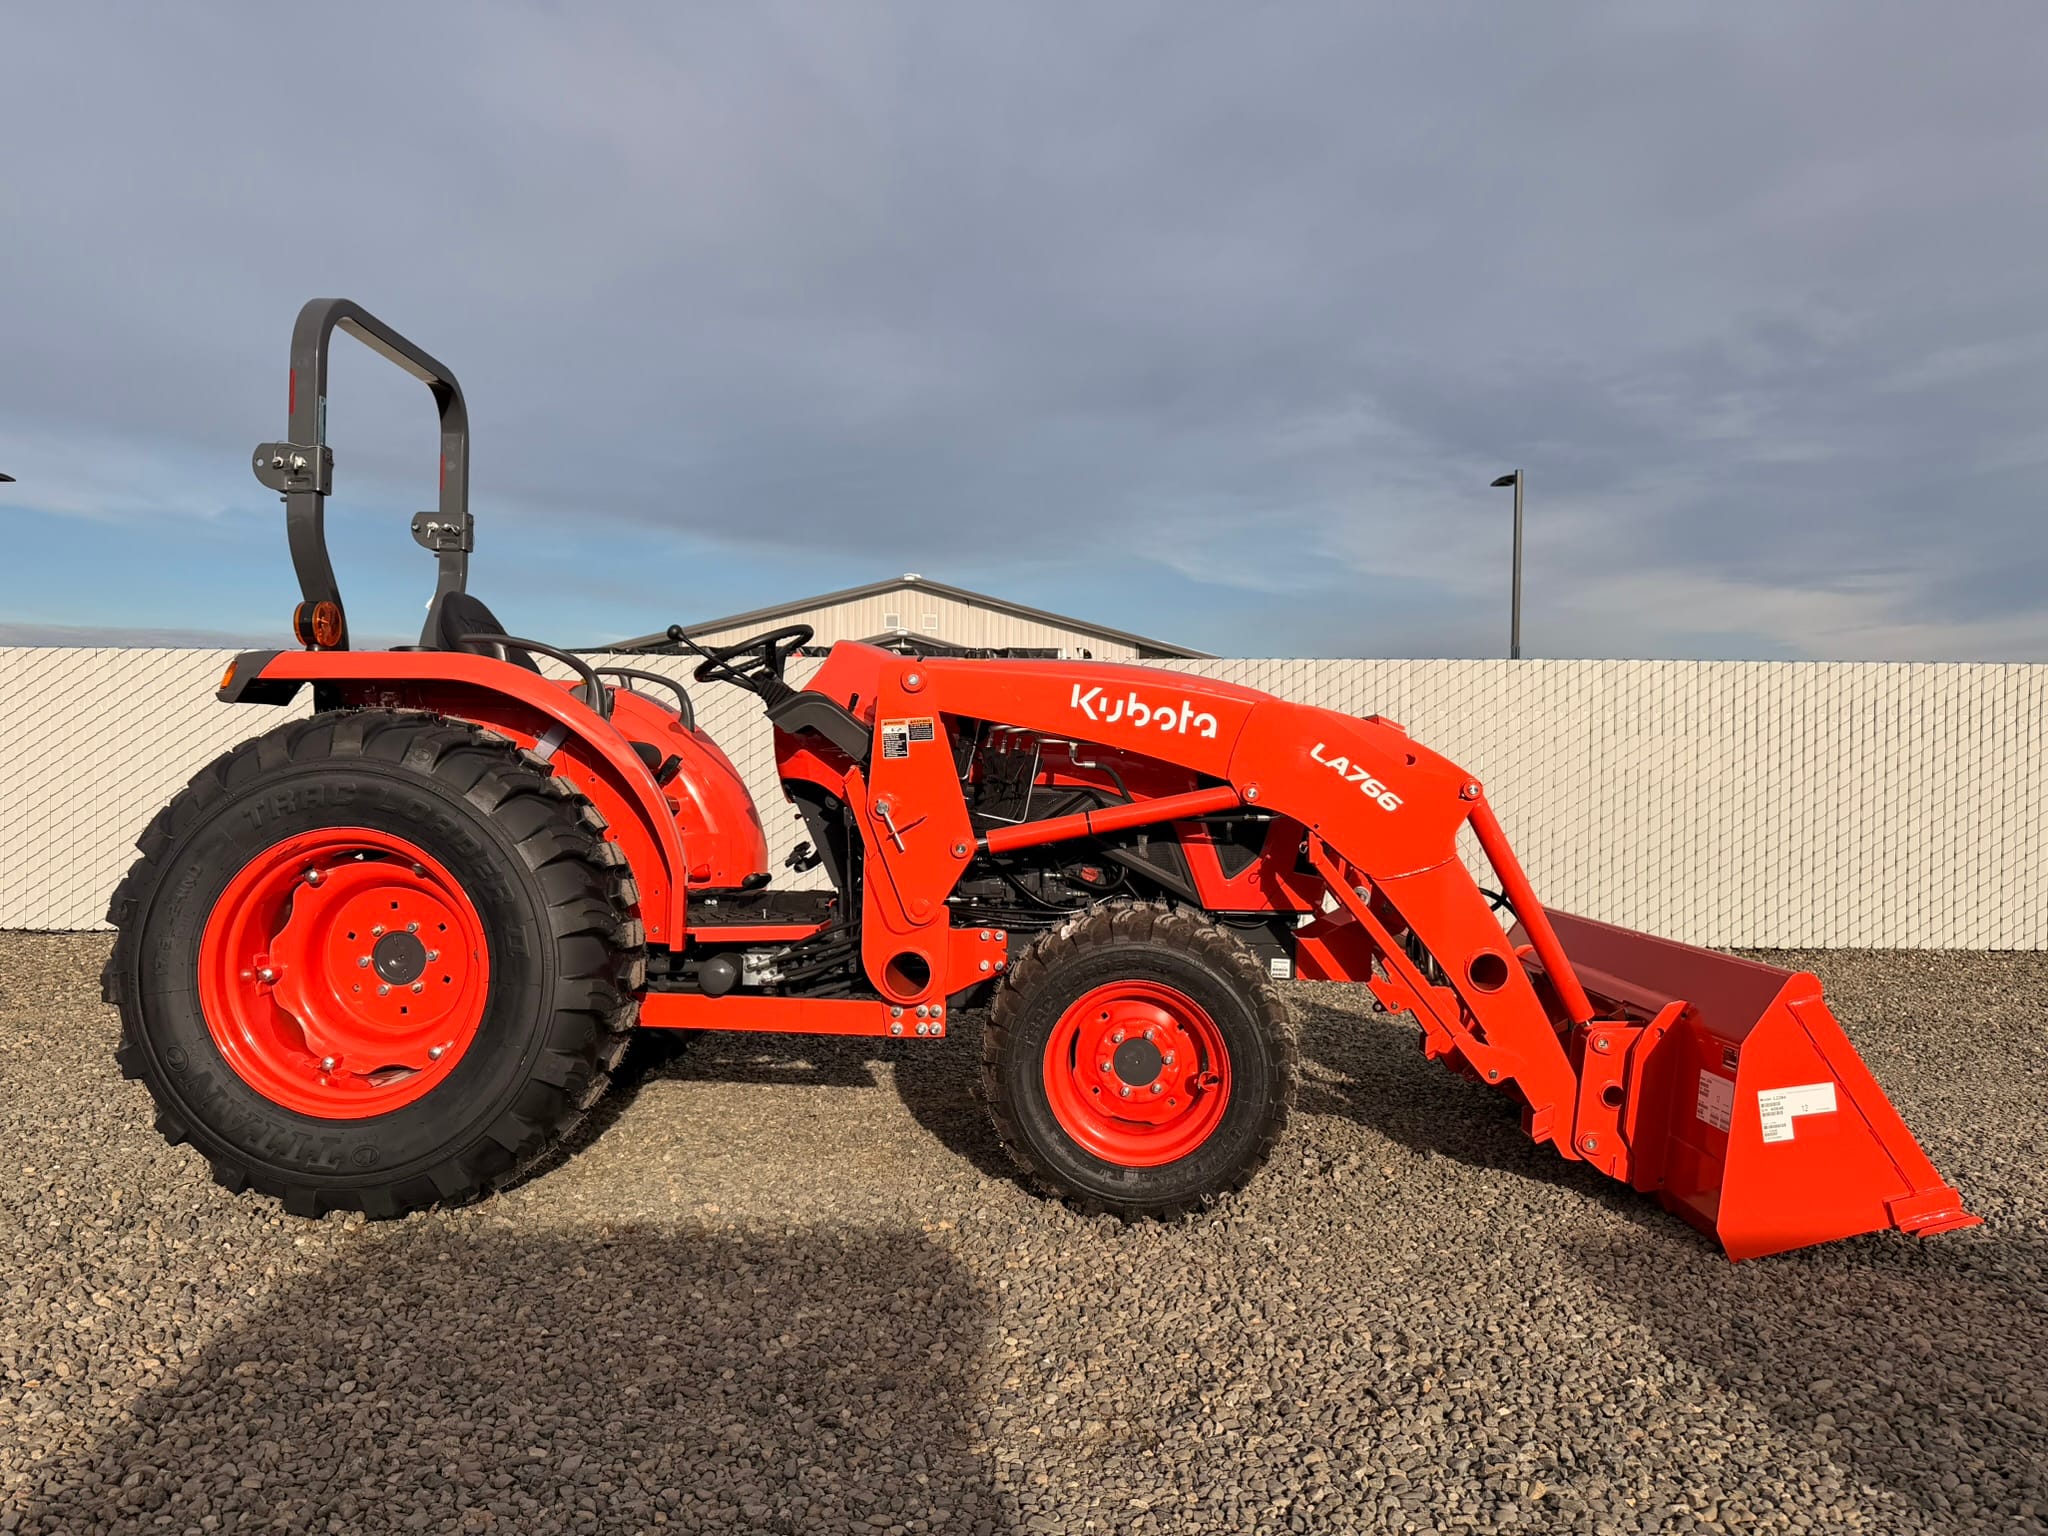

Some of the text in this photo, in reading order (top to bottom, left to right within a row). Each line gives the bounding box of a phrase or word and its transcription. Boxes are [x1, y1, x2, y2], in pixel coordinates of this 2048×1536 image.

[1070, 683, 1218, 739] Kubota
[243, 782, 357, 829] TRAC
[1309, 742, 1404, 813] LA766
[179, 1070, 344, 1171] TITAN
